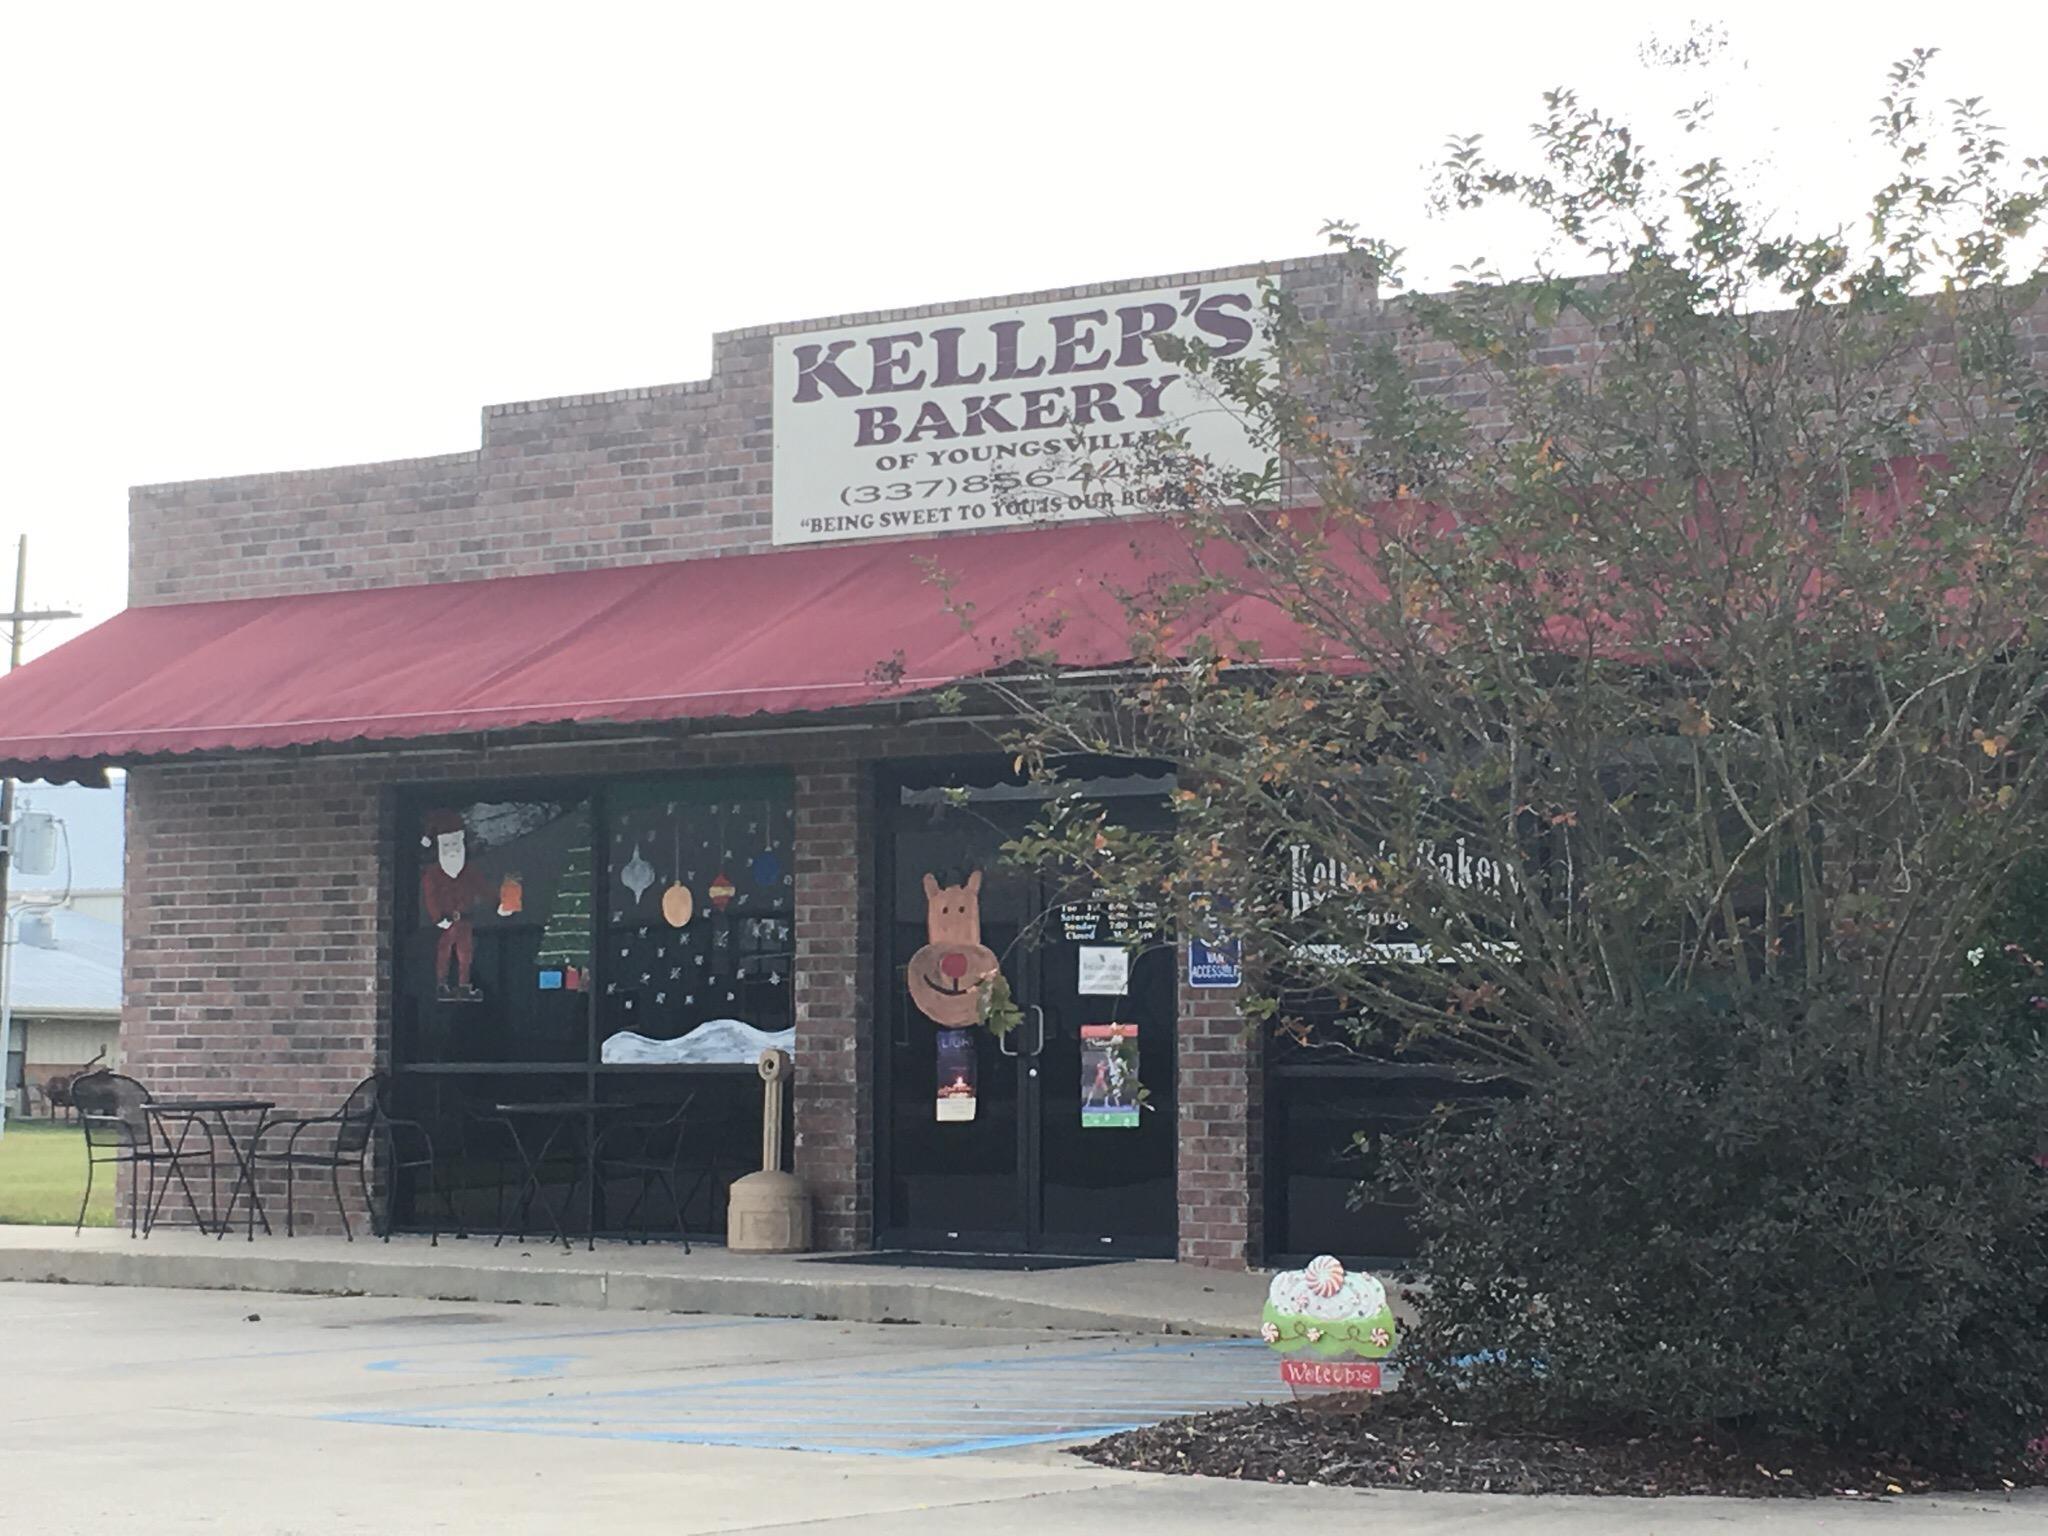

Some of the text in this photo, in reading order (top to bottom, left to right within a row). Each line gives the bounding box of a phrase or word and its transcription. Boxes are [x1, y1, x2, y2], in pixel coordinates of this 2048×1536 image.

[791, 289, 1254, 404] KELLER'S
[853, 374, 1181, 448] BAKERY
[874, 454, 918, 472] OF
[879, 506, 953, 528] SWEET
[958, 502, 987, 520] TO
[1068, 491, 1115, 511] OUR
[1287, 1362, 1374, 1385] Welcome
